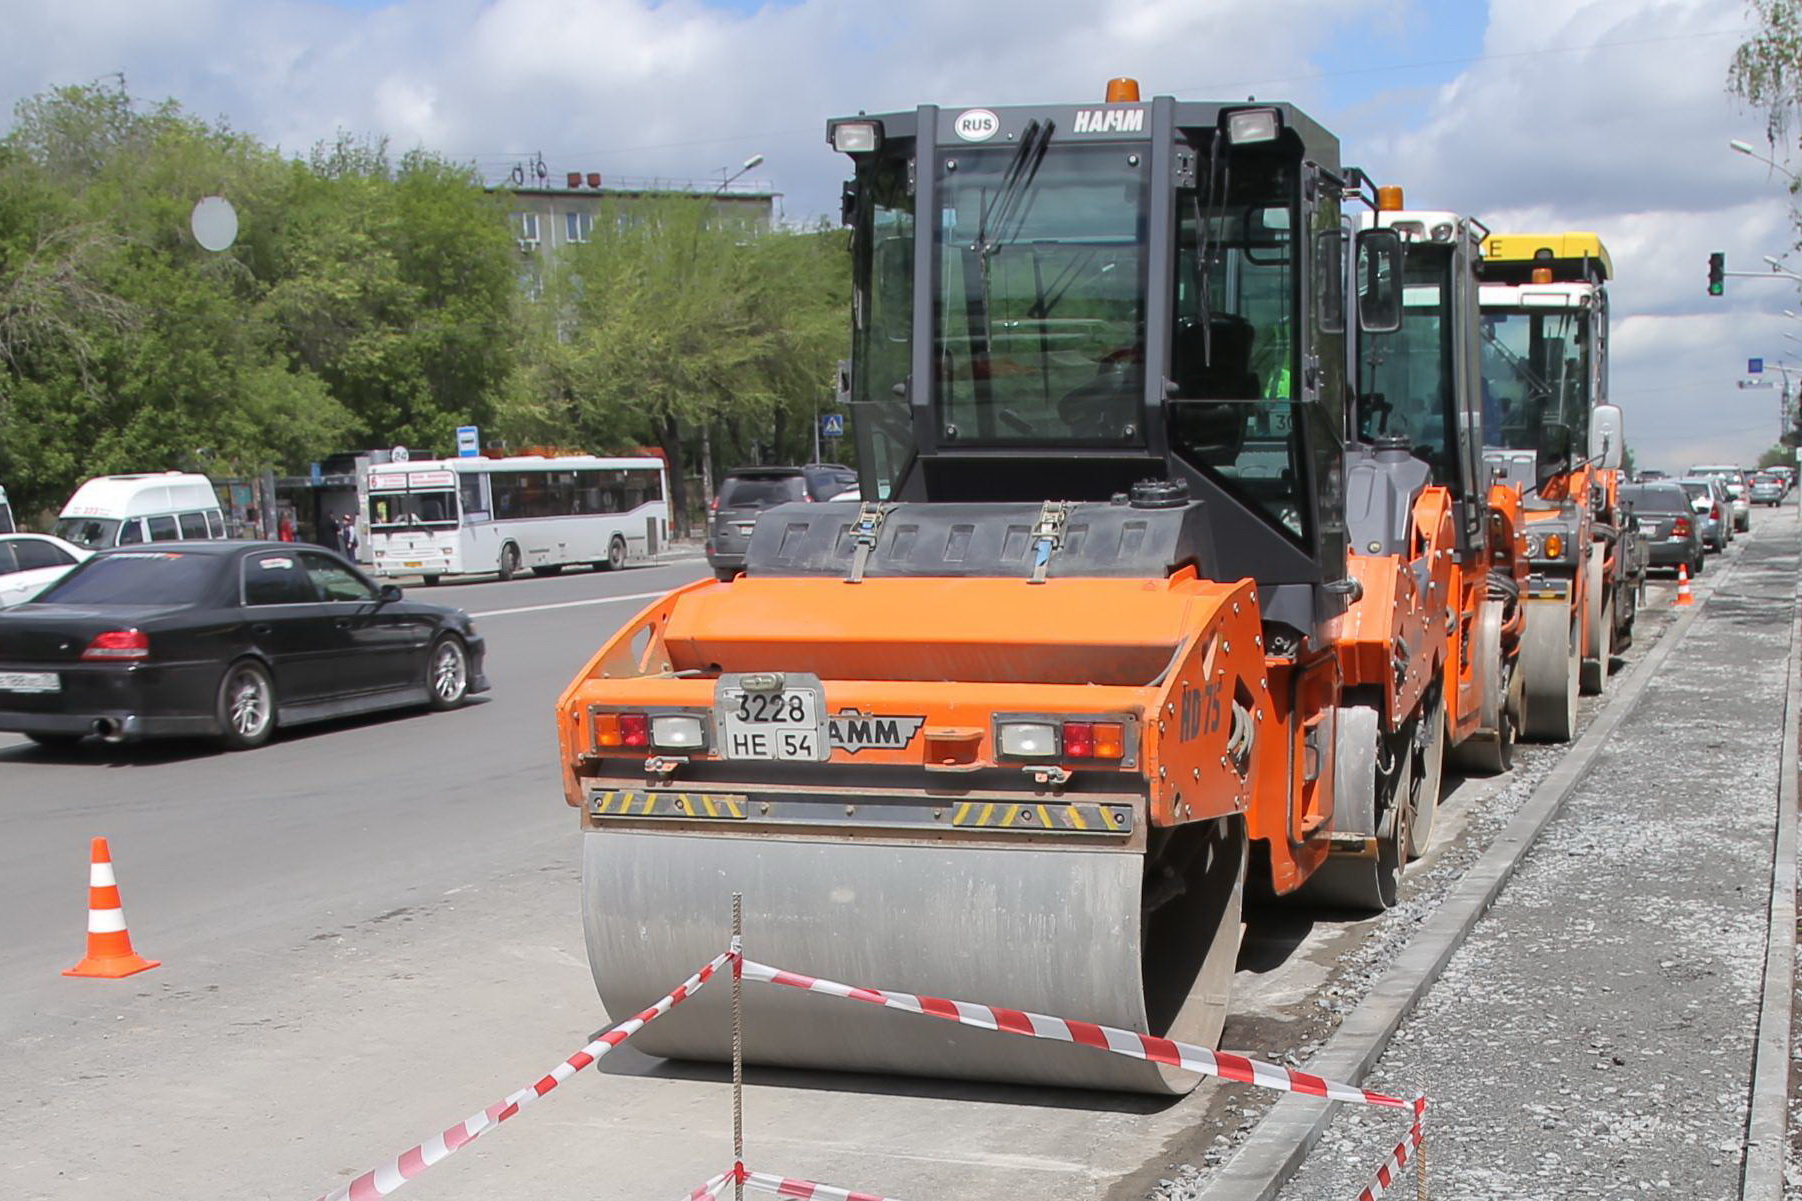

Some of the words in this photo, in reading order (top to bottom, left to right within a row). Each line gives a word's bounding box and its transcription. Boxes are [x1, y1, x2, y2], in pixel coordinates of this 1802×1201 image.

[962, 118, 992, 132] RUS
[1073, 108, 1145, 133] HAMM
[370, 476, 378, 488] 6
[734, 693, 805, 723] 3228
[1179, 687, 1202, 744] HD
[1203, 683, 1221, 736] 75
[829, 720, 900, 744] AMM
[733, 733, 767, 756] НЕ
[785, 734, 812, 757] 54
